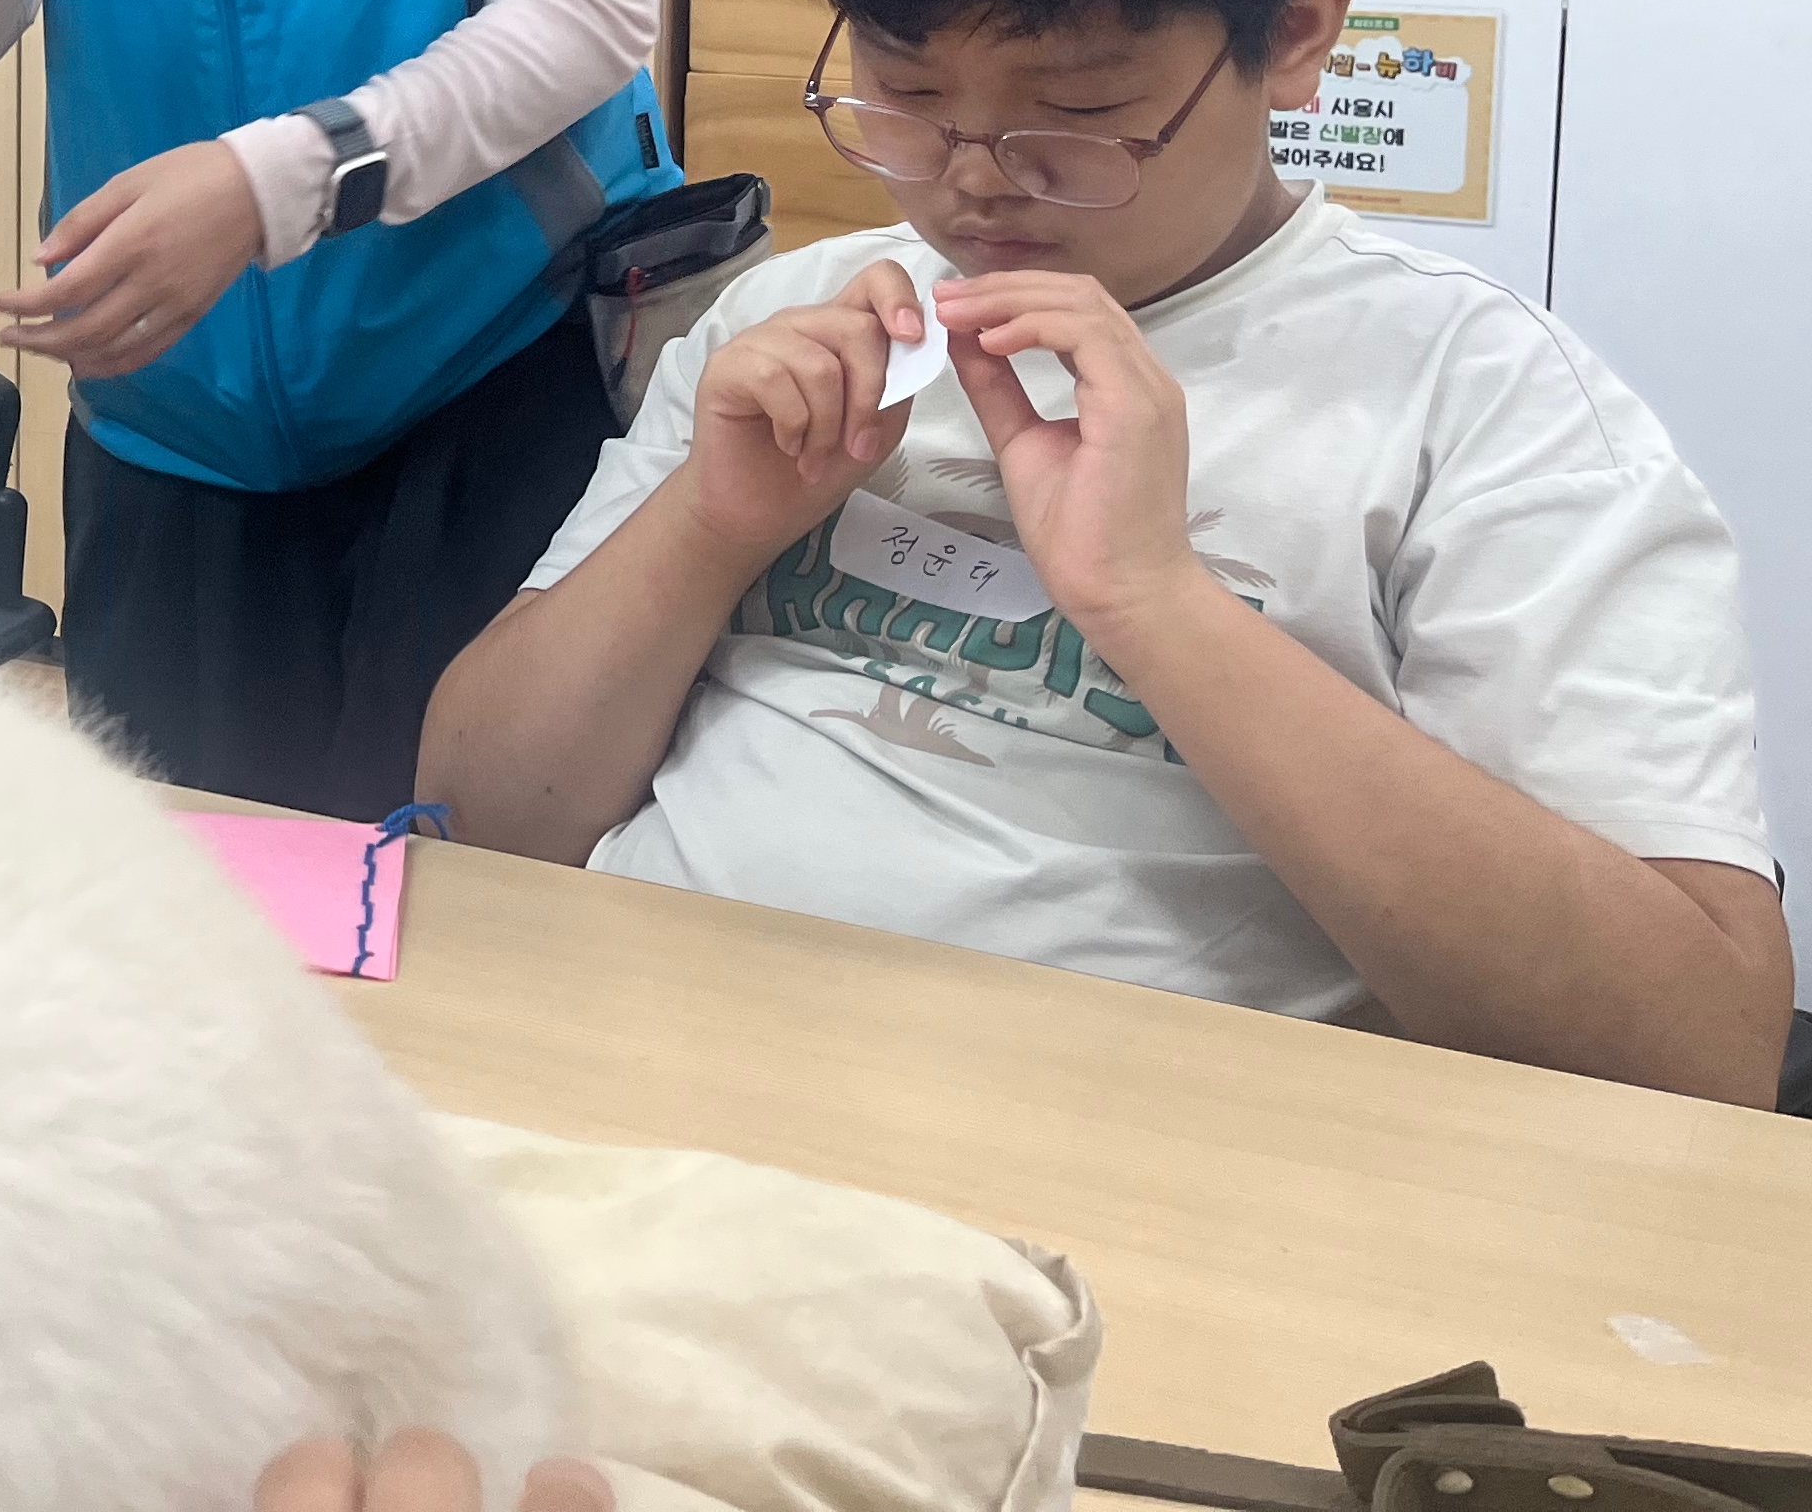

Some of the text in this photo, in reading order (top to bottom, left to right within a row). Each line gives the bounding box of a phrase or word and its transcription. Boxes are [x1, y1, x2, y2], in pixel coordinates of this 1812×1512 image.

[1331, 97, 1394, 119] 사용시
[1319, 123, 1405, 147] 신발장에
[1271, 146, 1385, 174] 넣어주세요!
